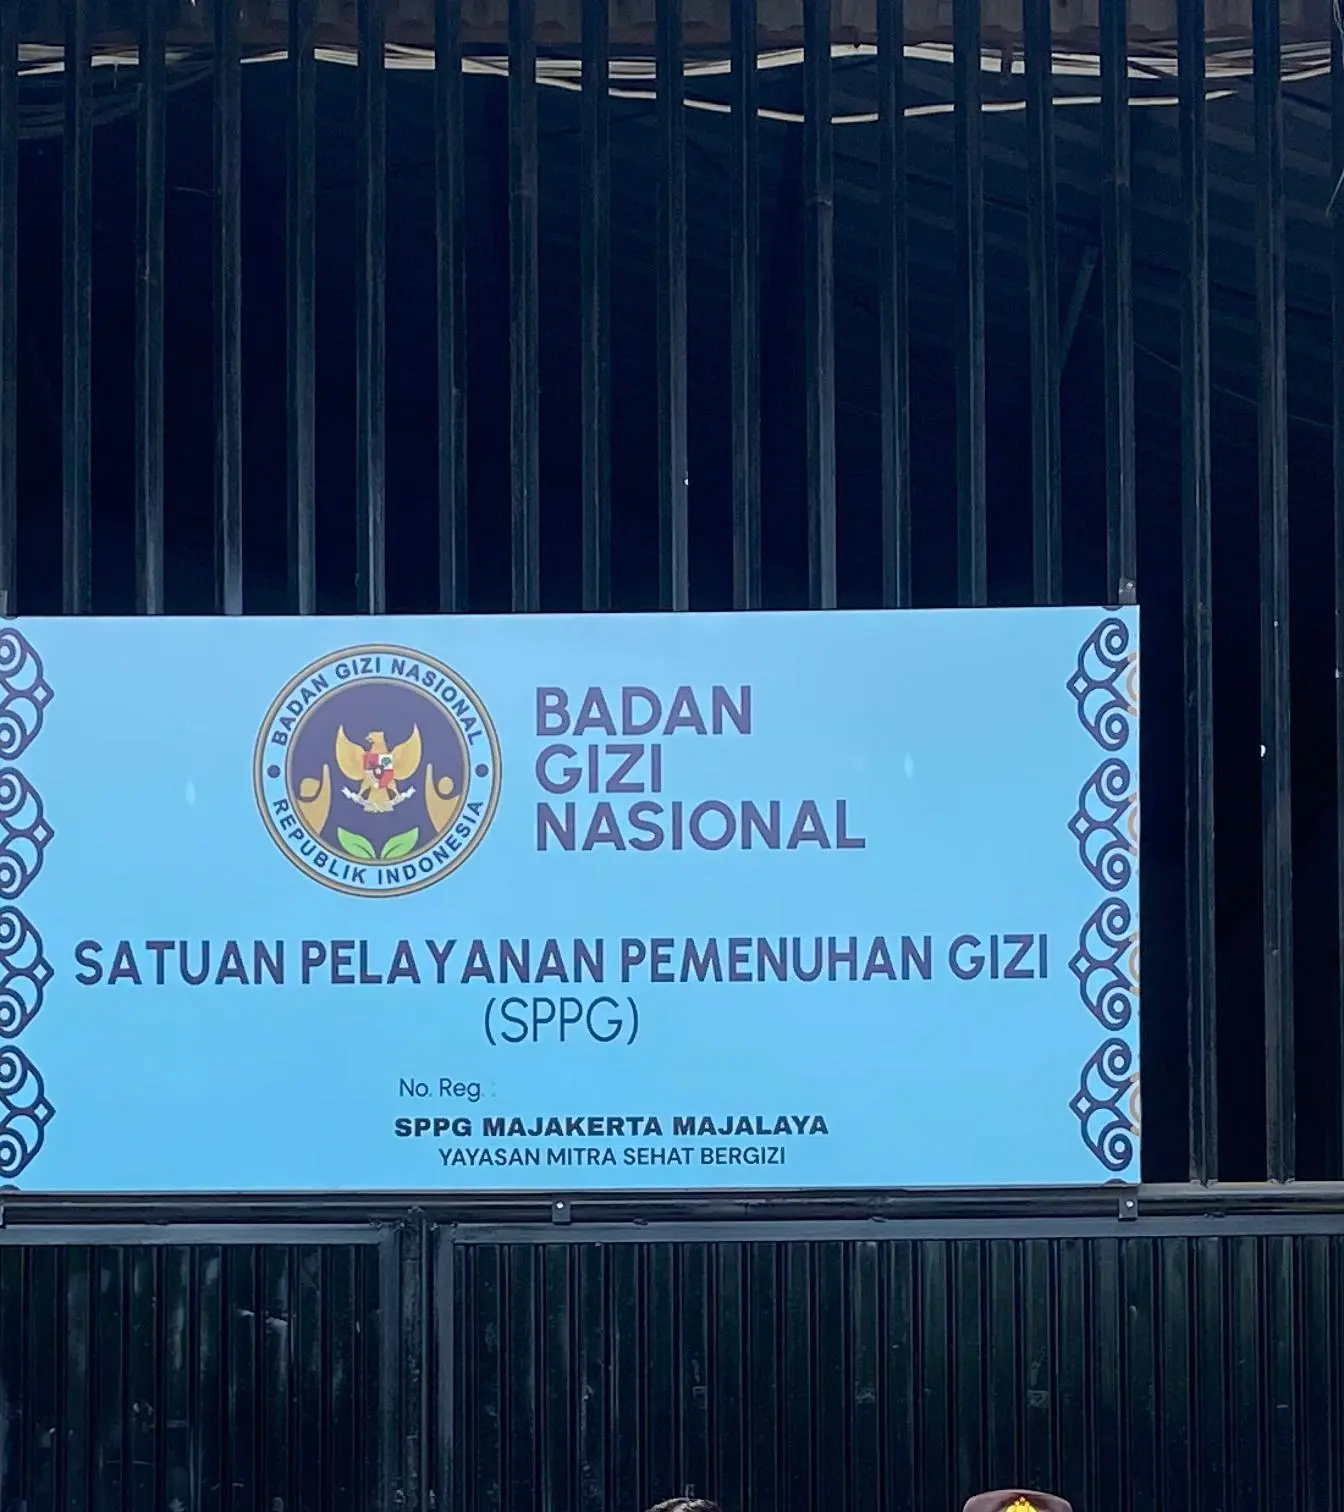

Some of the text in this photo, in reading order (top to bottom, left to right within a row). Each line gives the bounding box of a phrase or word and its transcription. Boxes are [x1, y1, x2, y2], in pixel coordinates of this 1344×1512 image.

[271, 656, 482, 748] BADAN GIZI NASIONAL
[535, 684, 752, 737] BADAN
[535, 743, 662, 795] GIZI
[272, 798, 484, 885] REPUBLIK INDONESIA
[536, 799, 866, 852] NASIONAL
[74, 933, 1048, 986] SATUAN PELAYANAN PEMENUHAN GIZI
[484, 995, 639, 1047] (SPPG)
[399, 1077, 434, 1098] No.
[439, 1077, 486, 1104] Reg.
[394, 1115, 830, 1138] SPPG MAJAKERTA MAJALAYA
[437, 1146, 786, 1167] YAYASAN MITRA SEHAT BERGIZI
